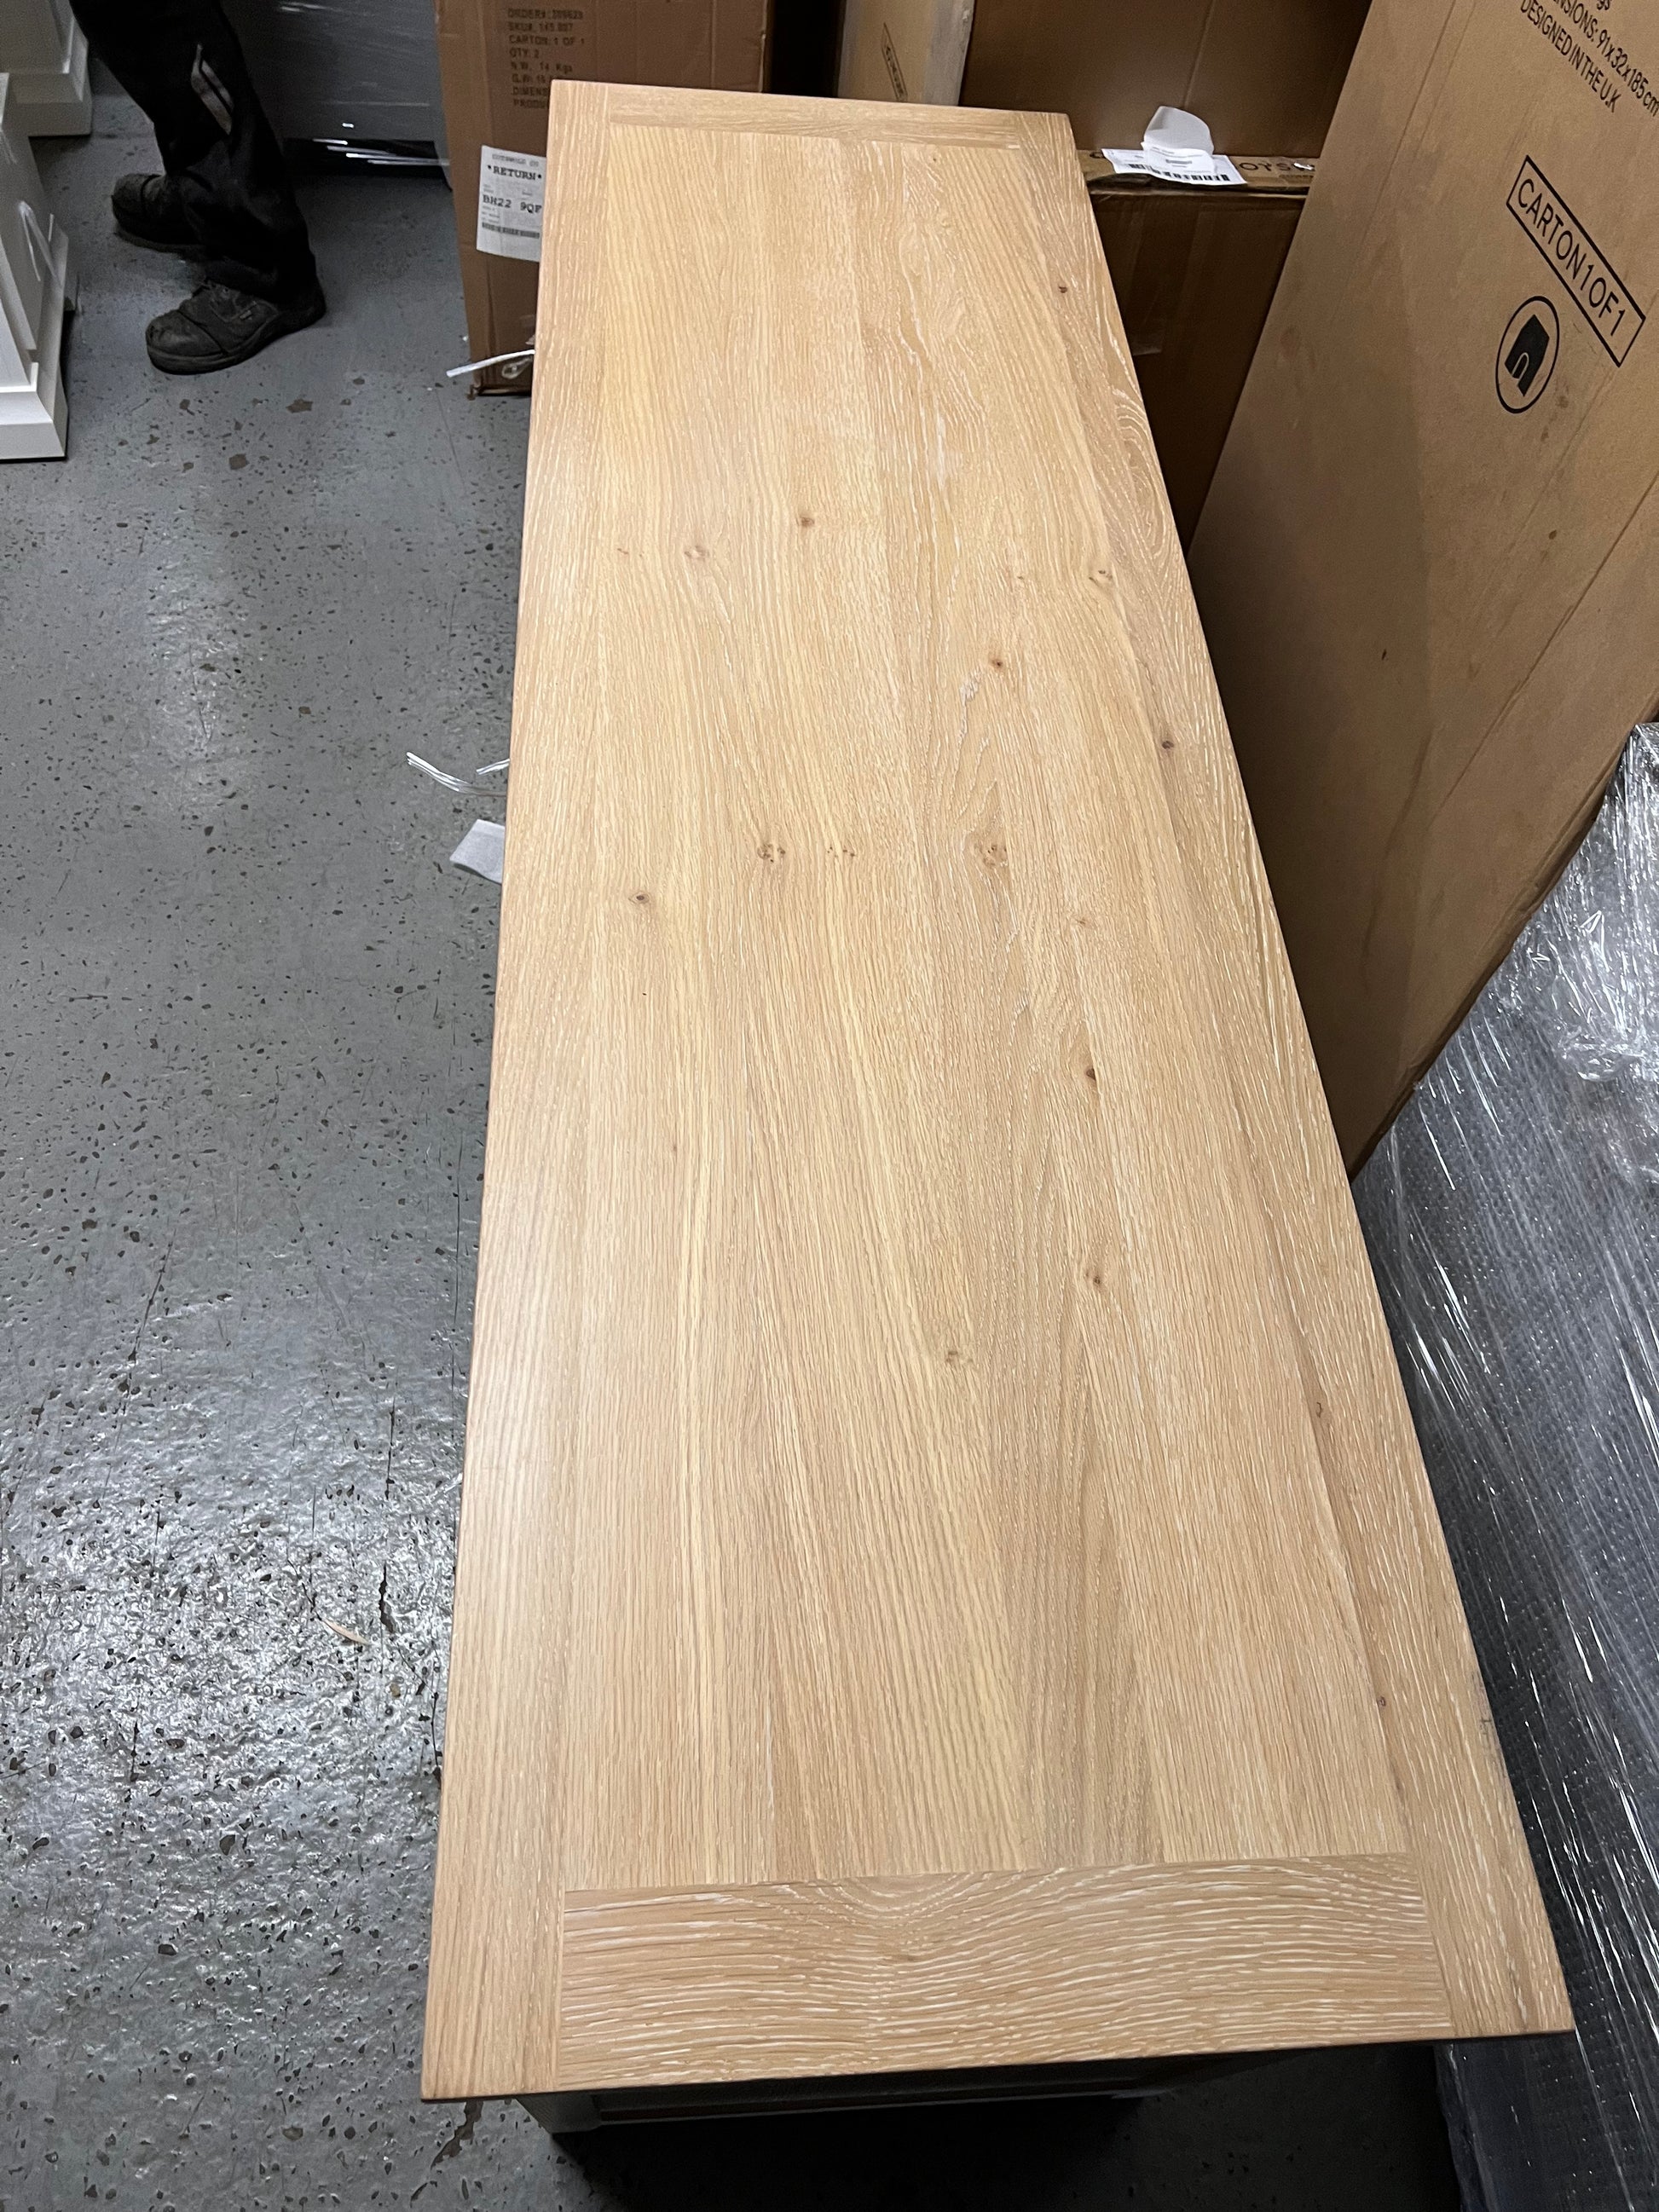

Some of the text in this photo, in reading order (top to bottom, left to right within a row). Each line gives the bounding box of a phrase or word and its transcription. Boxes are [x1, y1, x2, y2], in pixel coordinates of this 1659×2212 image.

[1520, 0, 1572, 55] DESIGNED
[1518, 178, 1626, 336] CARTON 1 OF 1
